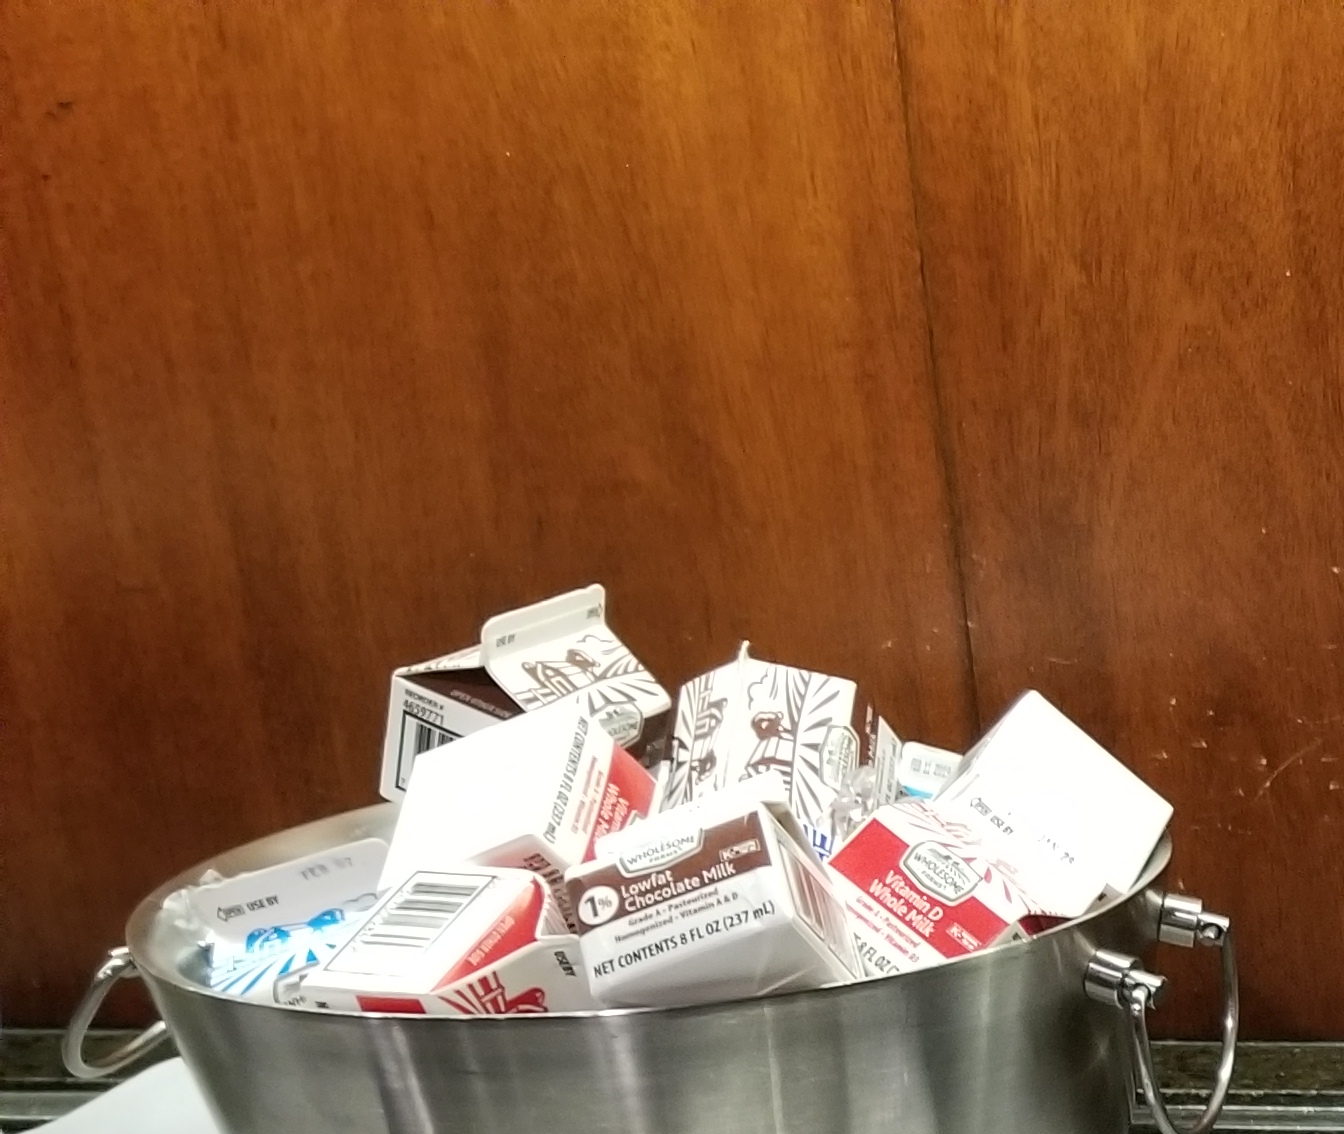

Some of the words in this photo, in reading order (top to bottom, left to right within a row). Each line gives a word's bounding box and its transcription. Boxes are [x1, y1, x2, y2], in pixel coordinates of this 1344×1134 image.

[610, 797, 629, 832] Vitam
[627, 834, 696, 866] WHOLESOME
[621, 869, 673, 898] Lowfat
[625, 876, 700, 912] Chocolate
[702, 862, 737, 884] Milk
[913, 852, 965, 895] WHOLESOME
[246, 898, 266, 912] USE
[265, 893, 280, 907] BY
[585, 893, 613, 919] 1%
[667, 887, 719, 914] Pasteurized
[680, 902, 715, 920] Vitamin
[869, 878, 908, 919] Whole
[905, 909, 936, 938] Milk
[884, 869, 930, 914] Vitamin
[928, 905, 944, 921] D
[593, 959, 616, 978] NET
[617, 935, 678, 969] CONTENTS
[680, 932, 688, 946] 8
[689, 927, 705, 943] FL
[705, 920, 722, 936] OZ
[723, 910, 750, 931] (237
[753, 900, 776, 920] mL)
